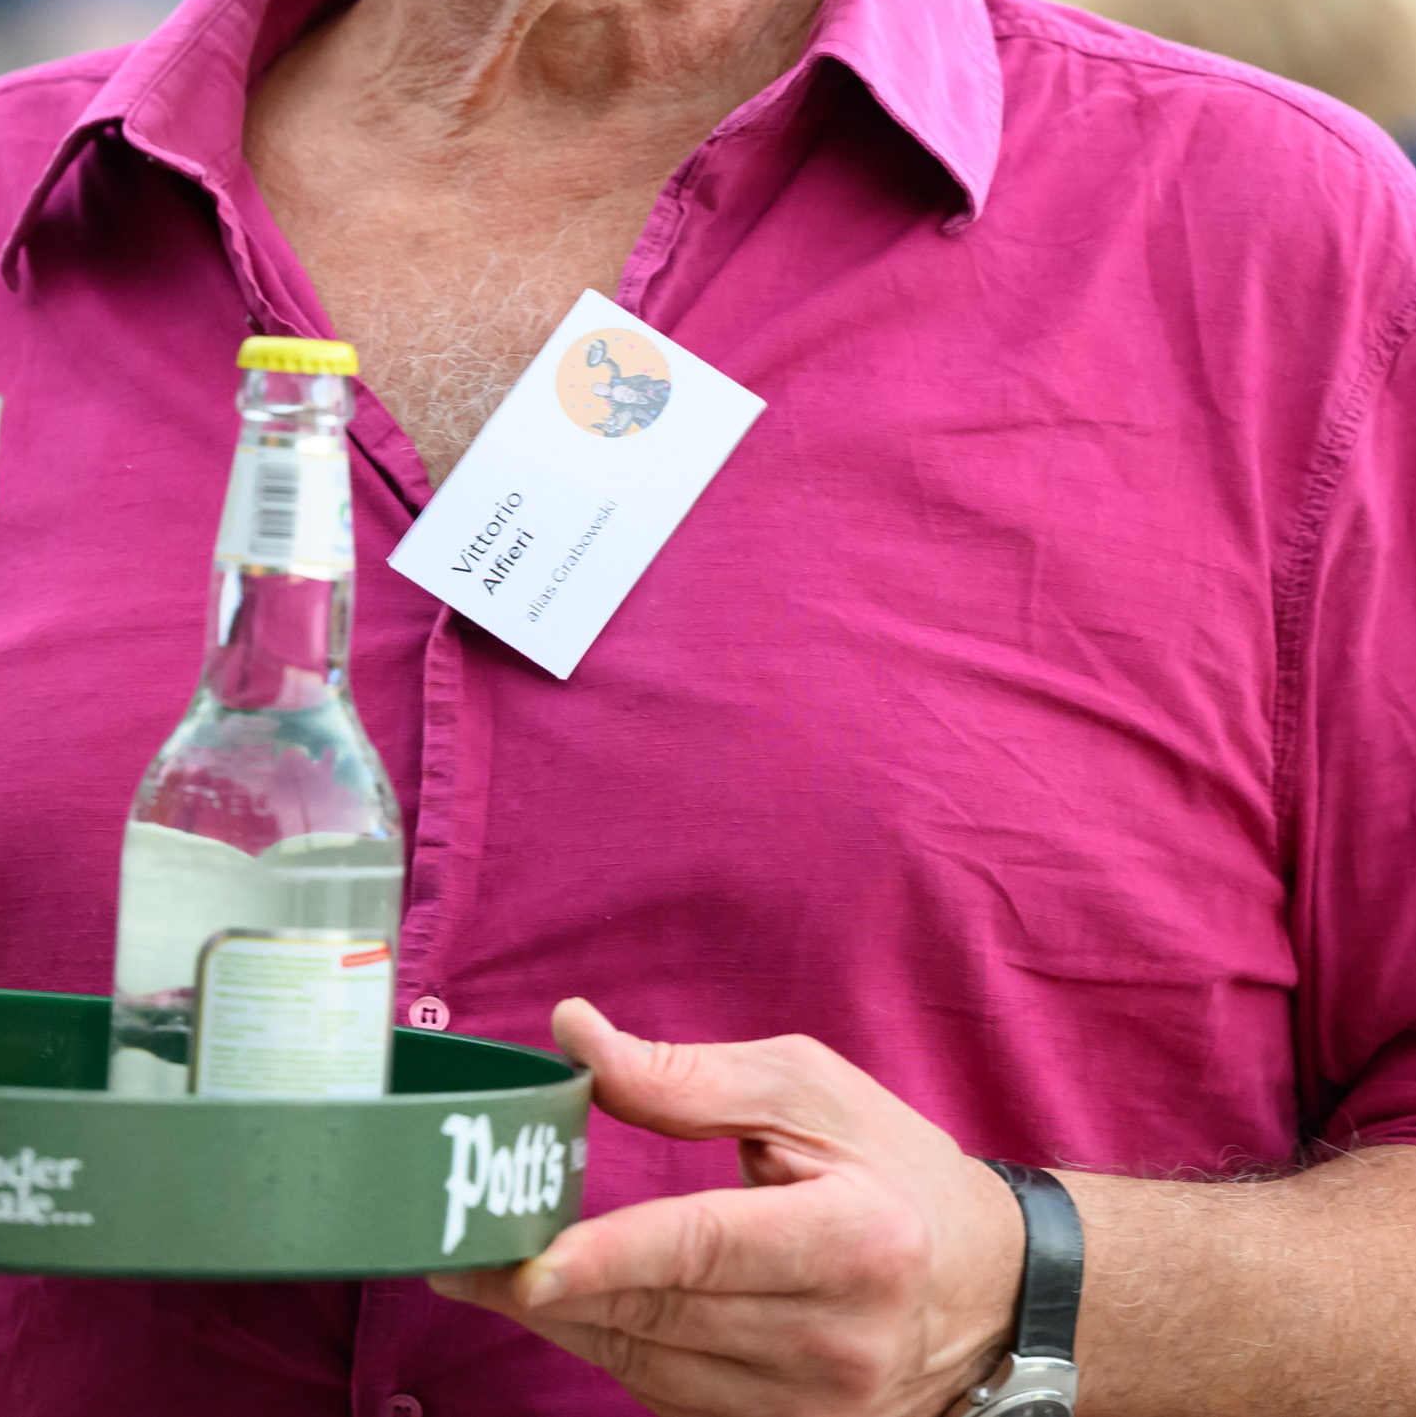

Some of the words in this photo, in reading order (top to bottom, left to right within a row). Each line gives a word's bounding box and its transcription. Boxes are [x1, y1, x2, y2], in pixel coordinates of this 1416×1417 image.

[451, 491, 524, 577] Vittorio
[481, 526, 535, 596] Alfieri
[524, 583, 559, 624] alias
[551, 497, 619, 584] Grabowski
[440, 1113, 566, 1256] Pott's
